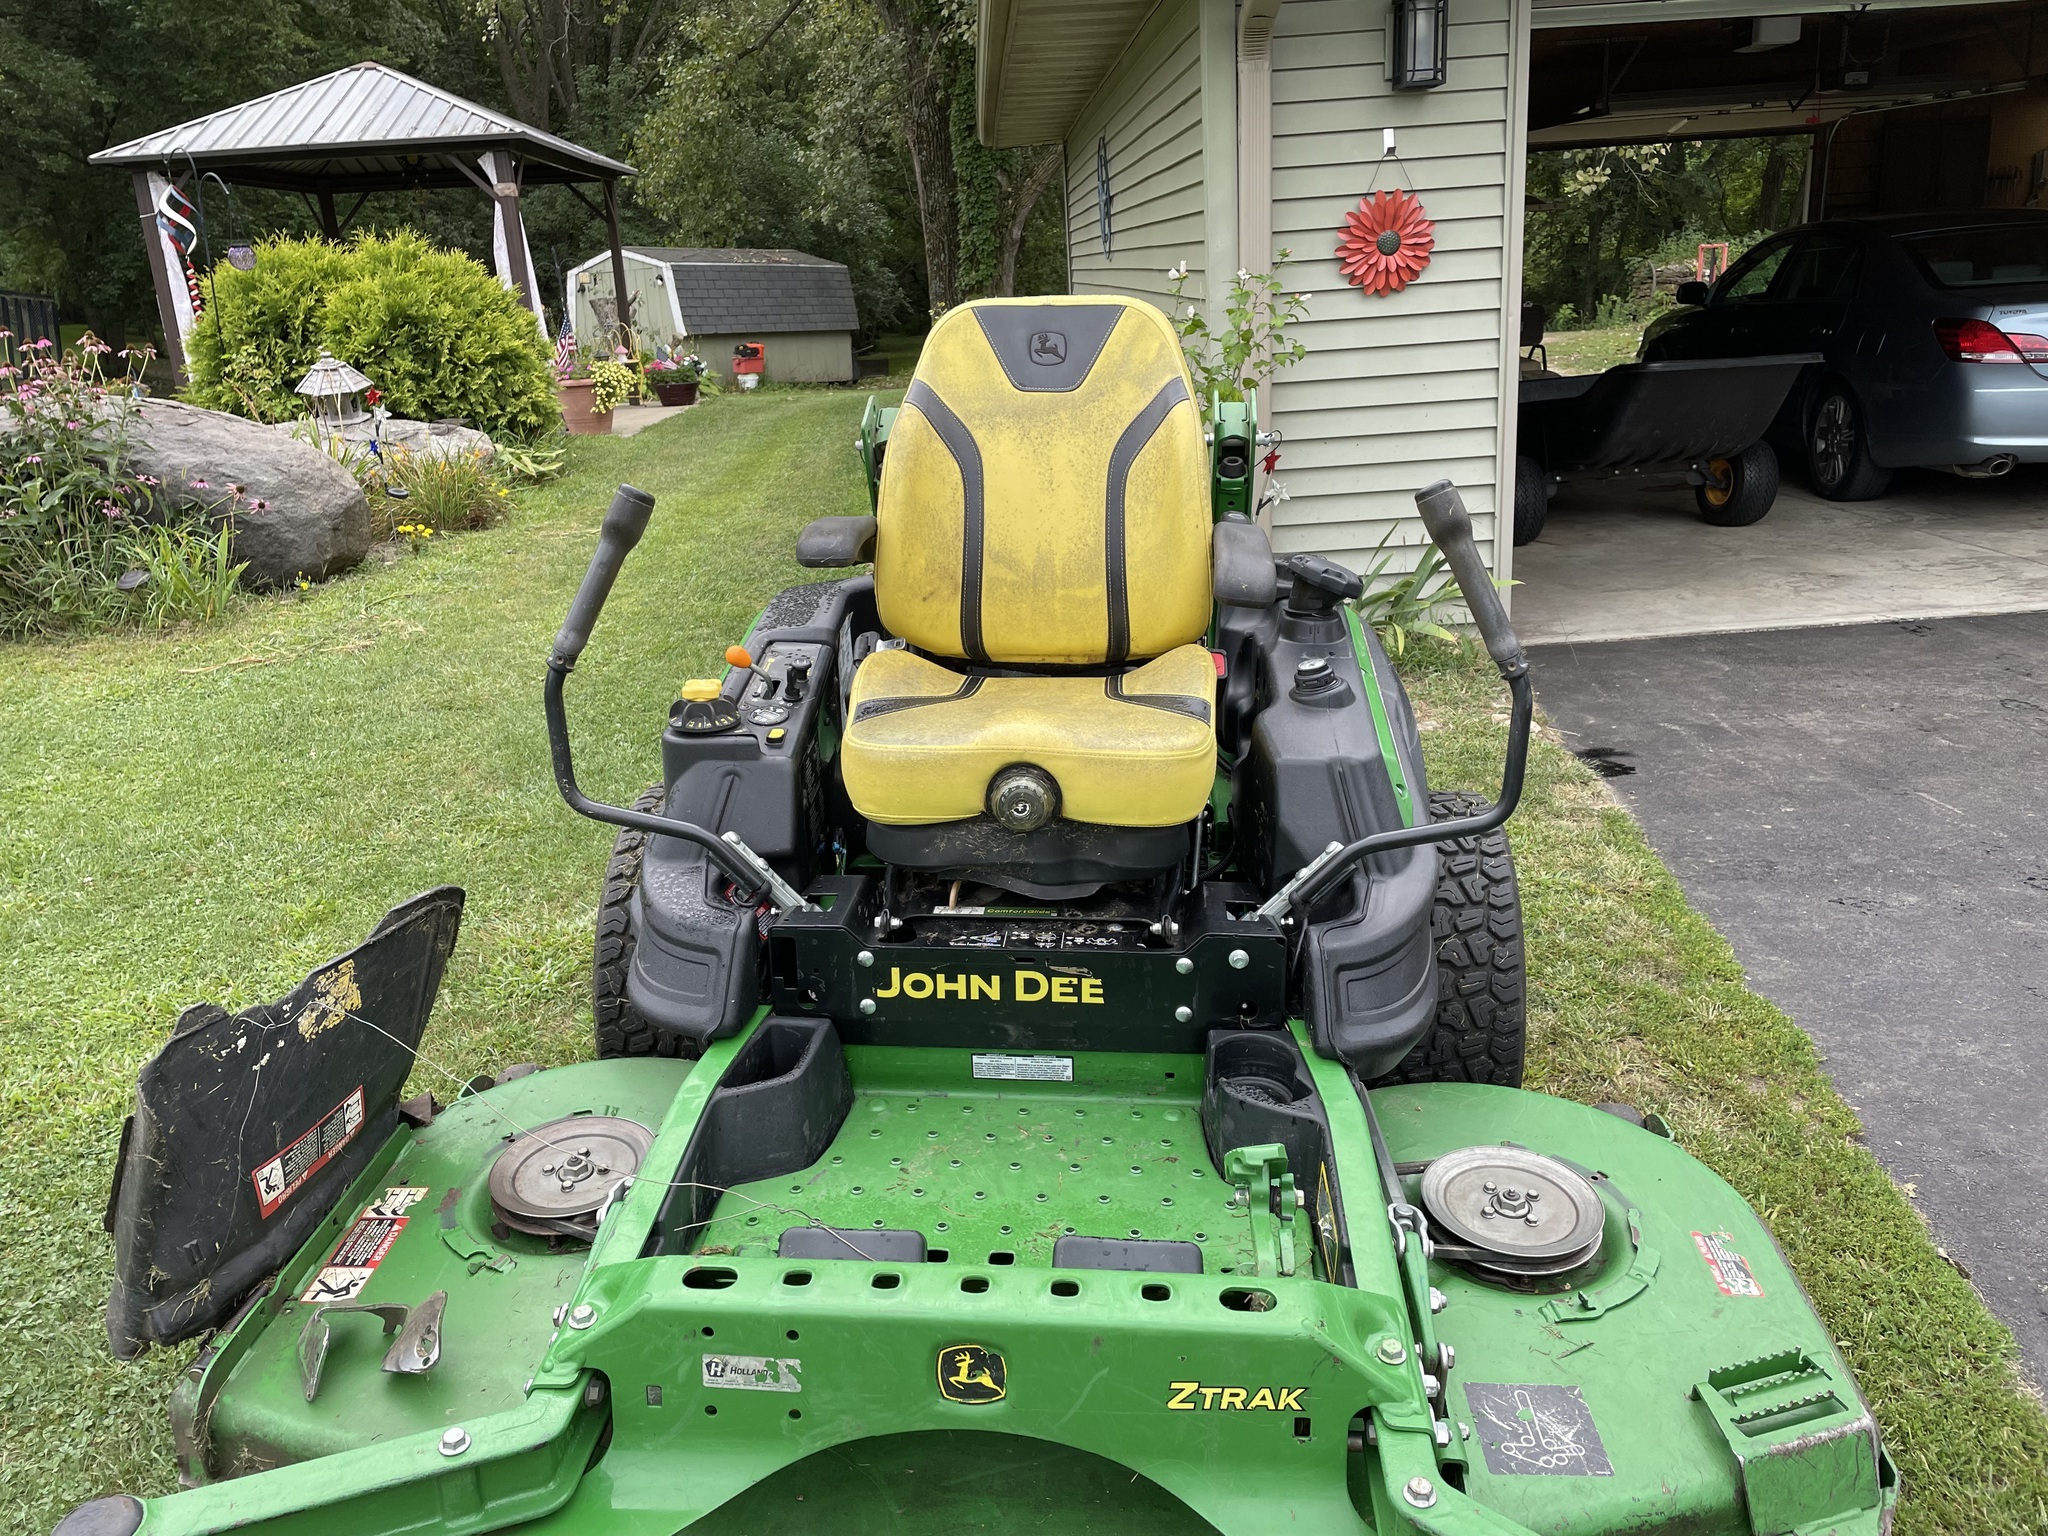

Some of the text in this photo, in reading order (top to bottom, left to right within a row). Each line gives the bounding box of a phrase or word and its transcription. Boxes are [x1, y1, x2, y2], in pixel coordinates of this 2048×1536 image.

[876, 967, 1105, 1004] JOHN DEE
[327, 1136, 351, 1159] DANGER
[278, 1177, 302, 1204] PELIGRO
[372, 1230, 398, 1261] DANGER
[1166, 1381, 1310, 1412] ZTRAK
